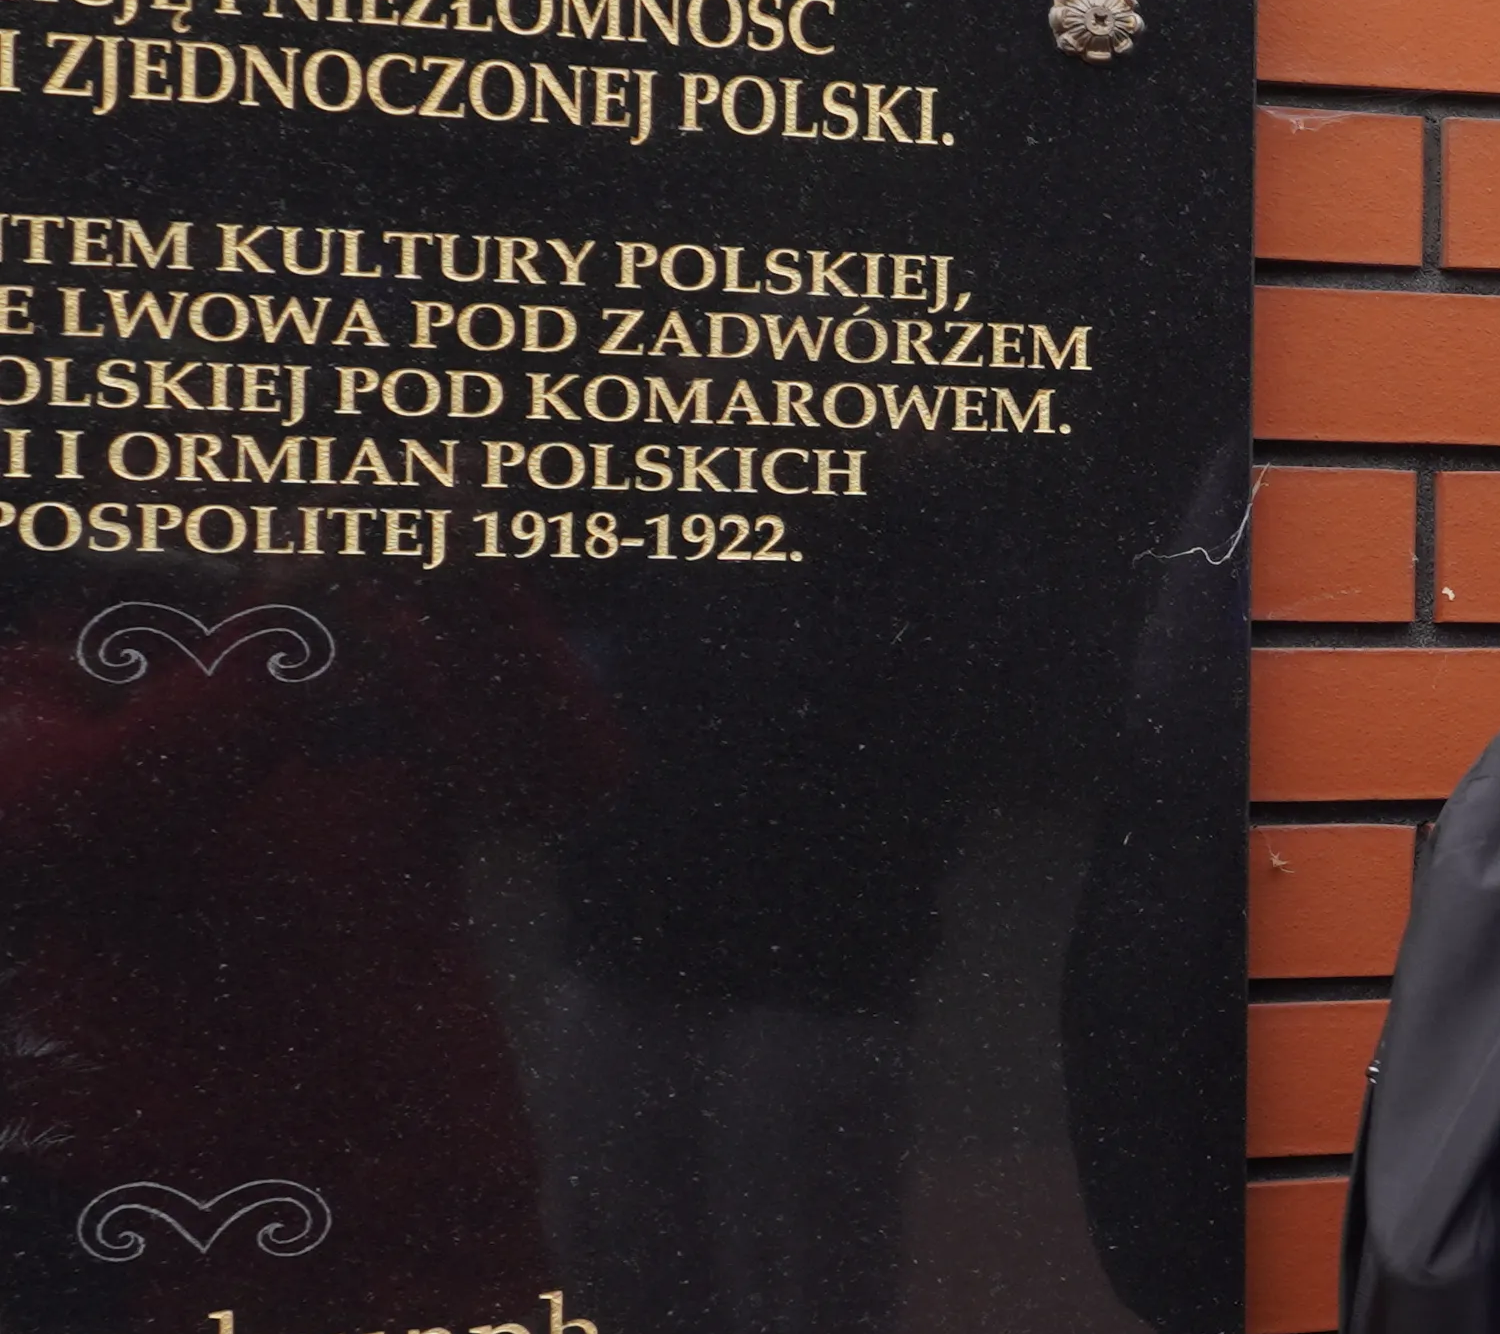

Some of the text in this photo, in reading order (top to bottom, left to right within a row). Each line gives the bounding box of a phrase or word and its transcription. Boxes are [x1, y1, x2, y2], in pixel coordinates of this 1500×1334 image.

[42, 31, 656, 147] ZJEDNOCZONEJ
[678, 73, 956, 148] POLSKI.
[0, 212, 973, 315] TEM KULTURY POLSKIEJ,
[59, 286, 390, 348] LWOWA
[410, 300, 578, 353] POD
[598, 304, 1093, 371] ZADWÓRZEM
[334, 366, 504, 418] POD
[526, 371, 1073, 435] KOMAROWEM.
[55, 430, 85, 480] I
[107, 431, 460, 487] ORMIAN
[481, 440, 868, 496] POLSKICH
[473, 510, 803, 563] 1918-1922.
